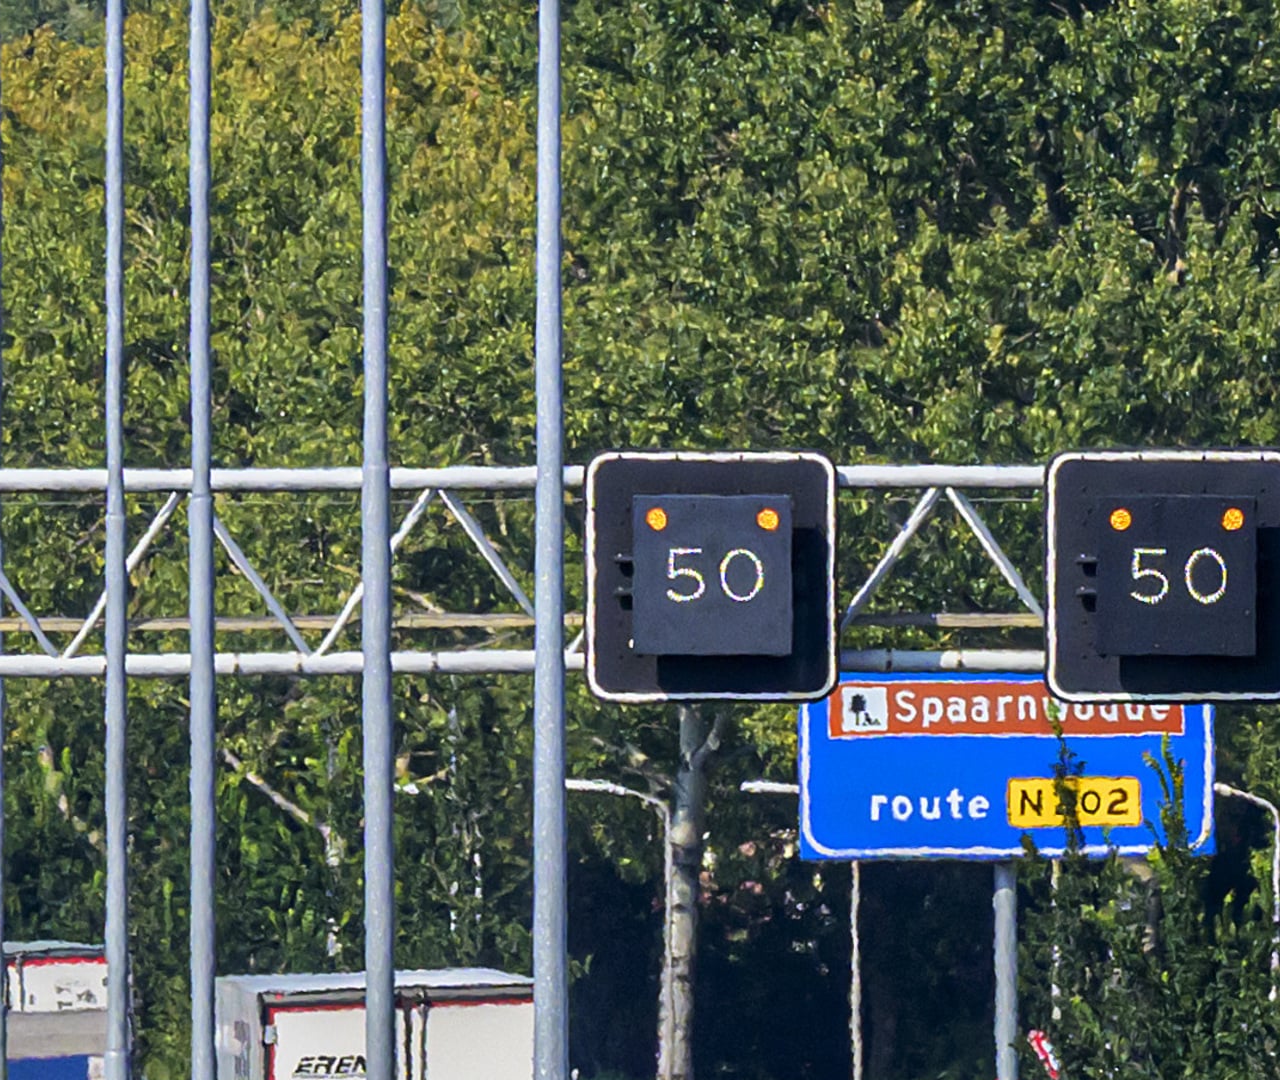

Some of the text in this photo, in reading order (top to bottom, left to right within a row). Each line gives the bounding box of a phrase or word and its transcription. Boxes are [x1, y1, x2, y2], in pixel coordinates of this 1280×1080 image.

[666, 547, 765, 603] 50
[1129, 547, 1228, 605] 50
[870, 788, 990, 822] route
